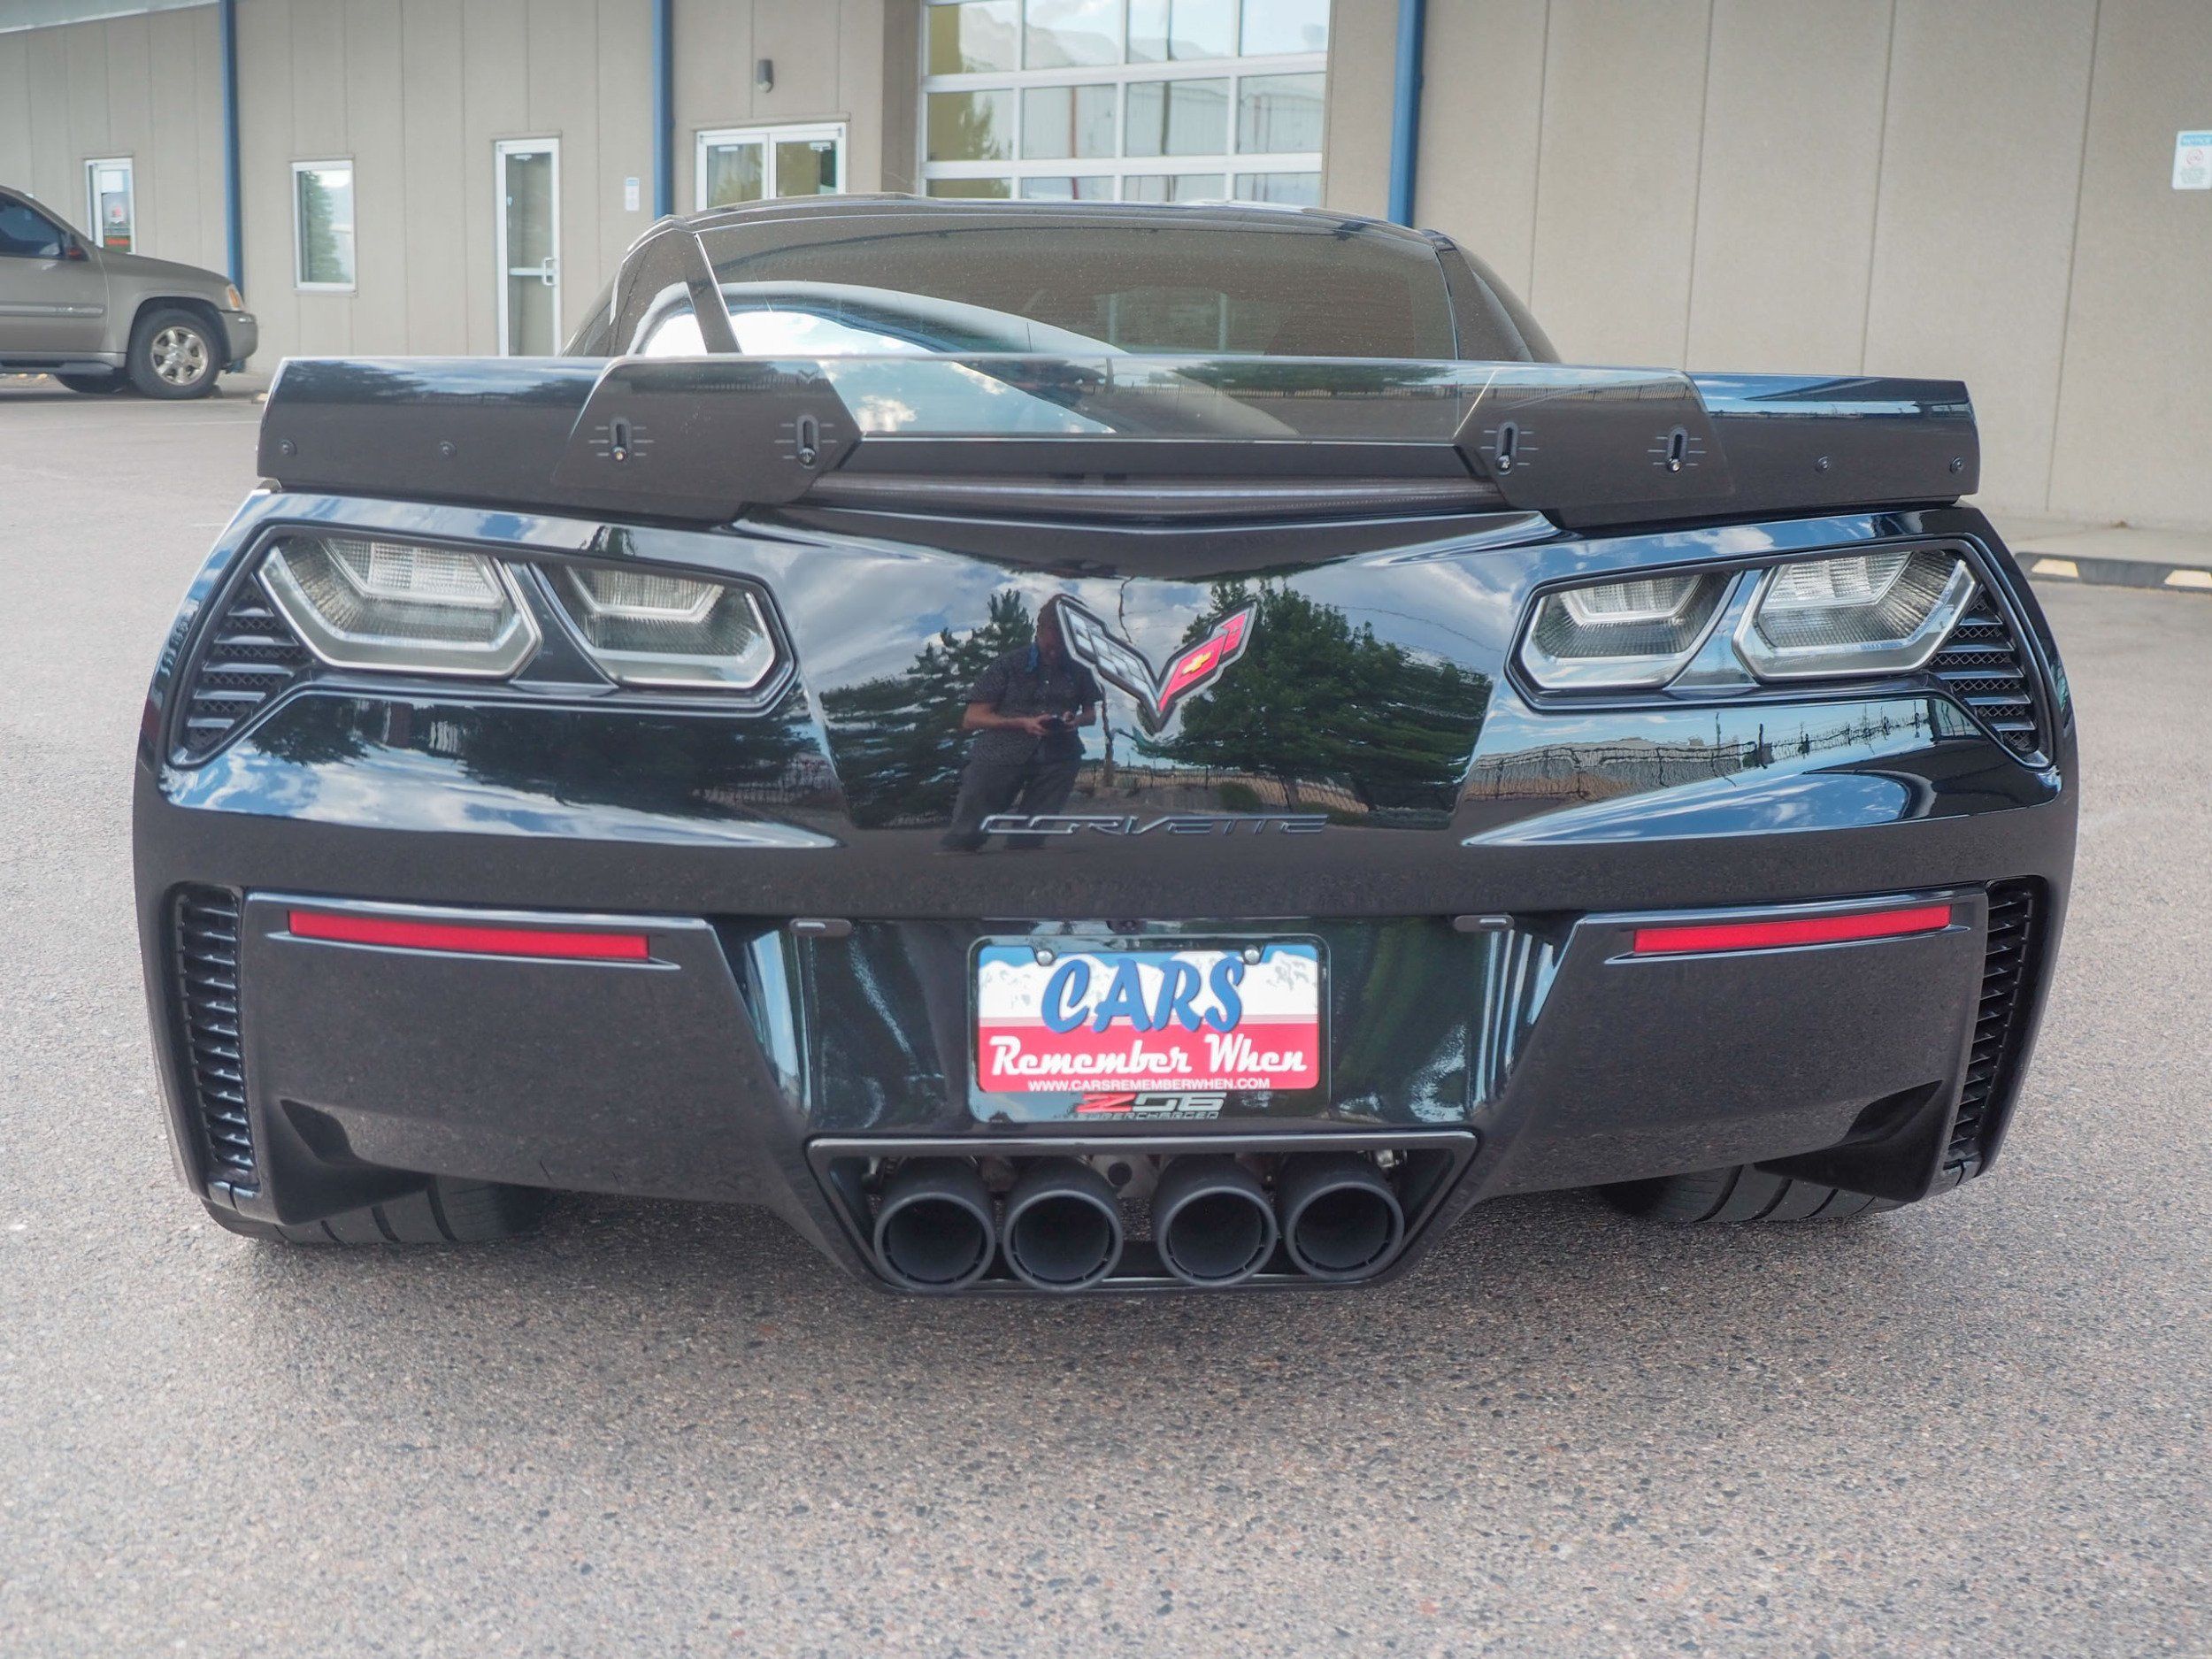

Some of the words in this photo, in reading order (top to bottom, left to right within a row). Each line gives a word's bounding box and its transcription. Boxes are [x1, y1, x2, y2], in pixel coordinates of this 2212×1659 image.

[980, 815, 1328, 834] CORVETTE
[1041, 957, 1245, 1033] CARS
[989, 1035, 1192, 1076] Remember
[1204, 1033, 1308, 1072] When
[1028, 1078, 1271, 1092] WWW.CARSREMEMBERWHEN.COM
[1076, 1092, 1227, 1112] Z06
